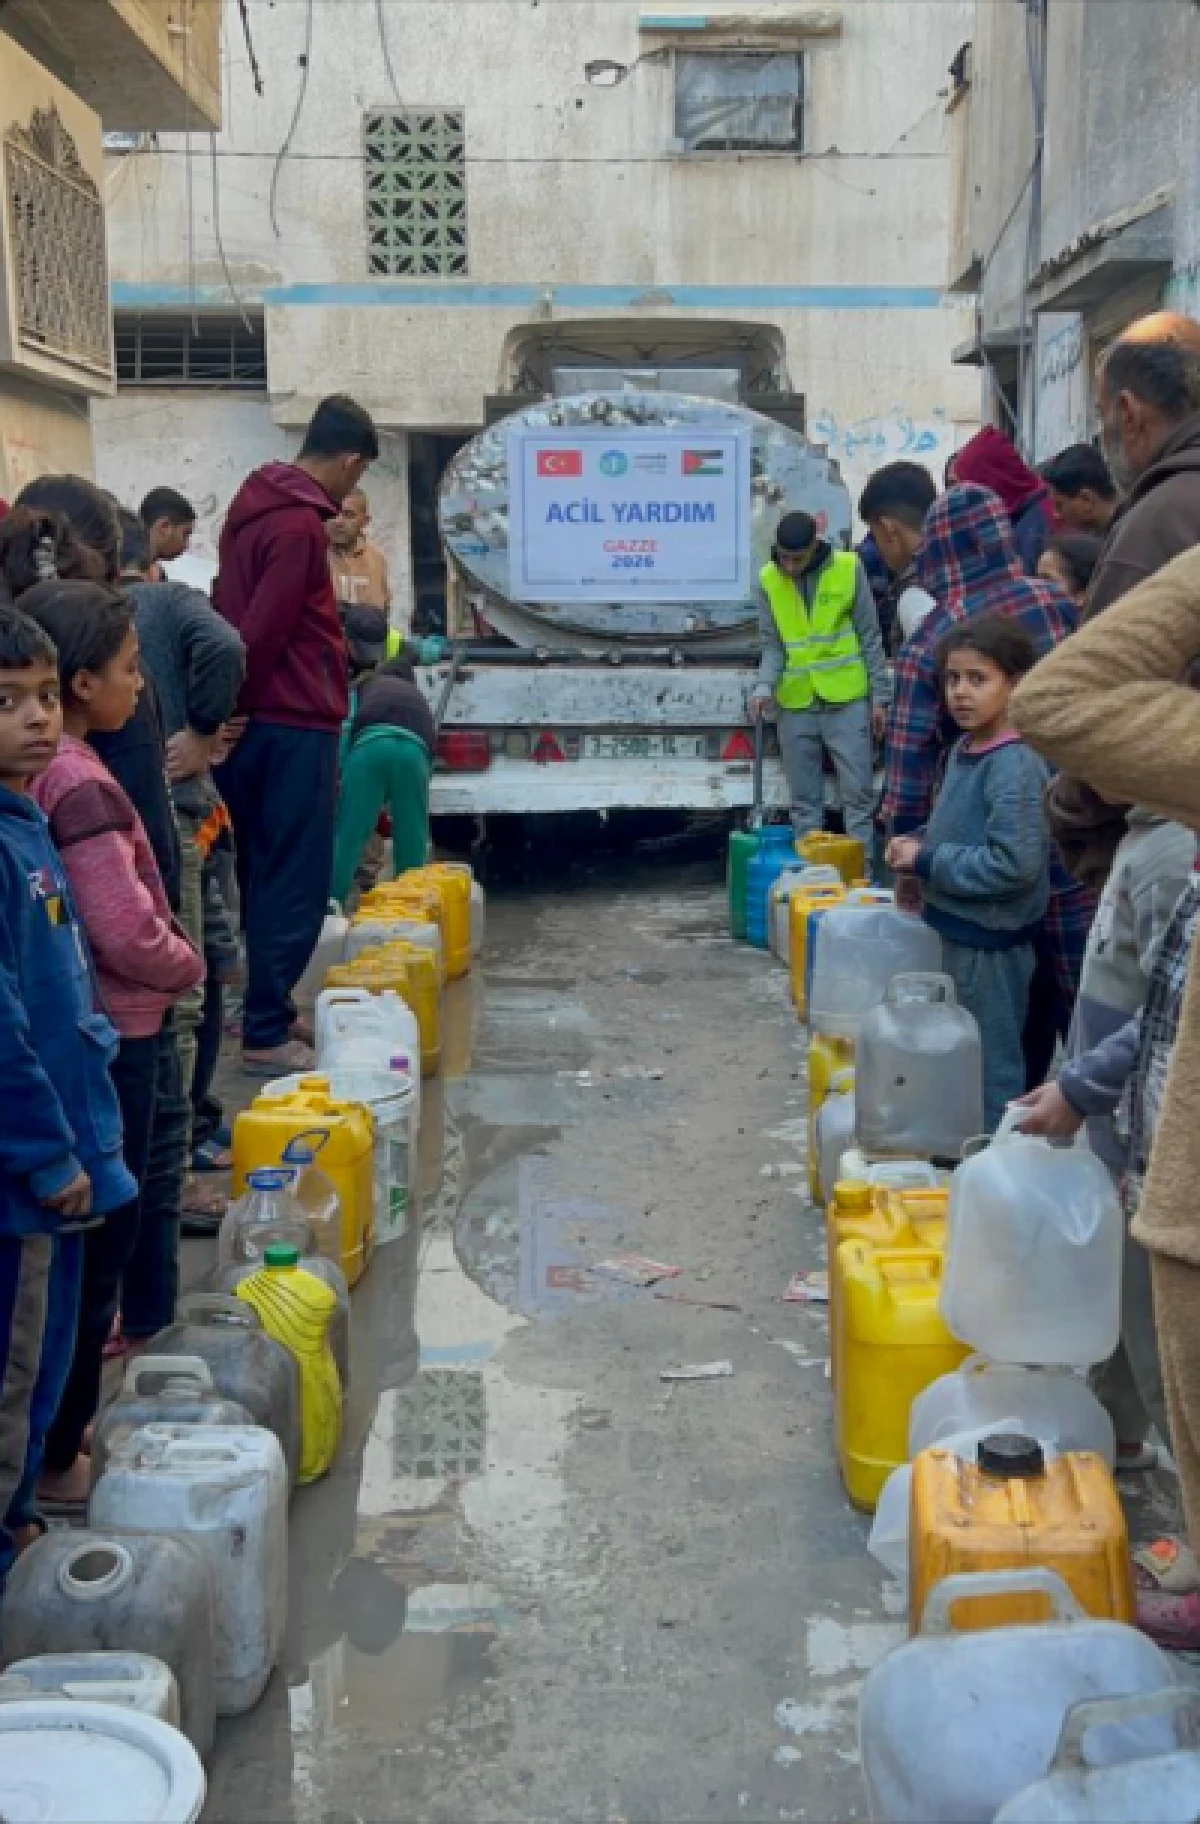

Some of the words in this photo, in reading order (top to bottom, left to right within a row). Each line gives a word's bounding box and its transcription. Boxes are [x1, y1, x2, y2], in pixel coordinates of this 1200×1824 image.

[546, 498, 605, 523] ACİL
[611, 502, 716, 523] YARDIM
[602, 540, 659, 553] GAZZE
[611, 555, 655, 568] 2026
